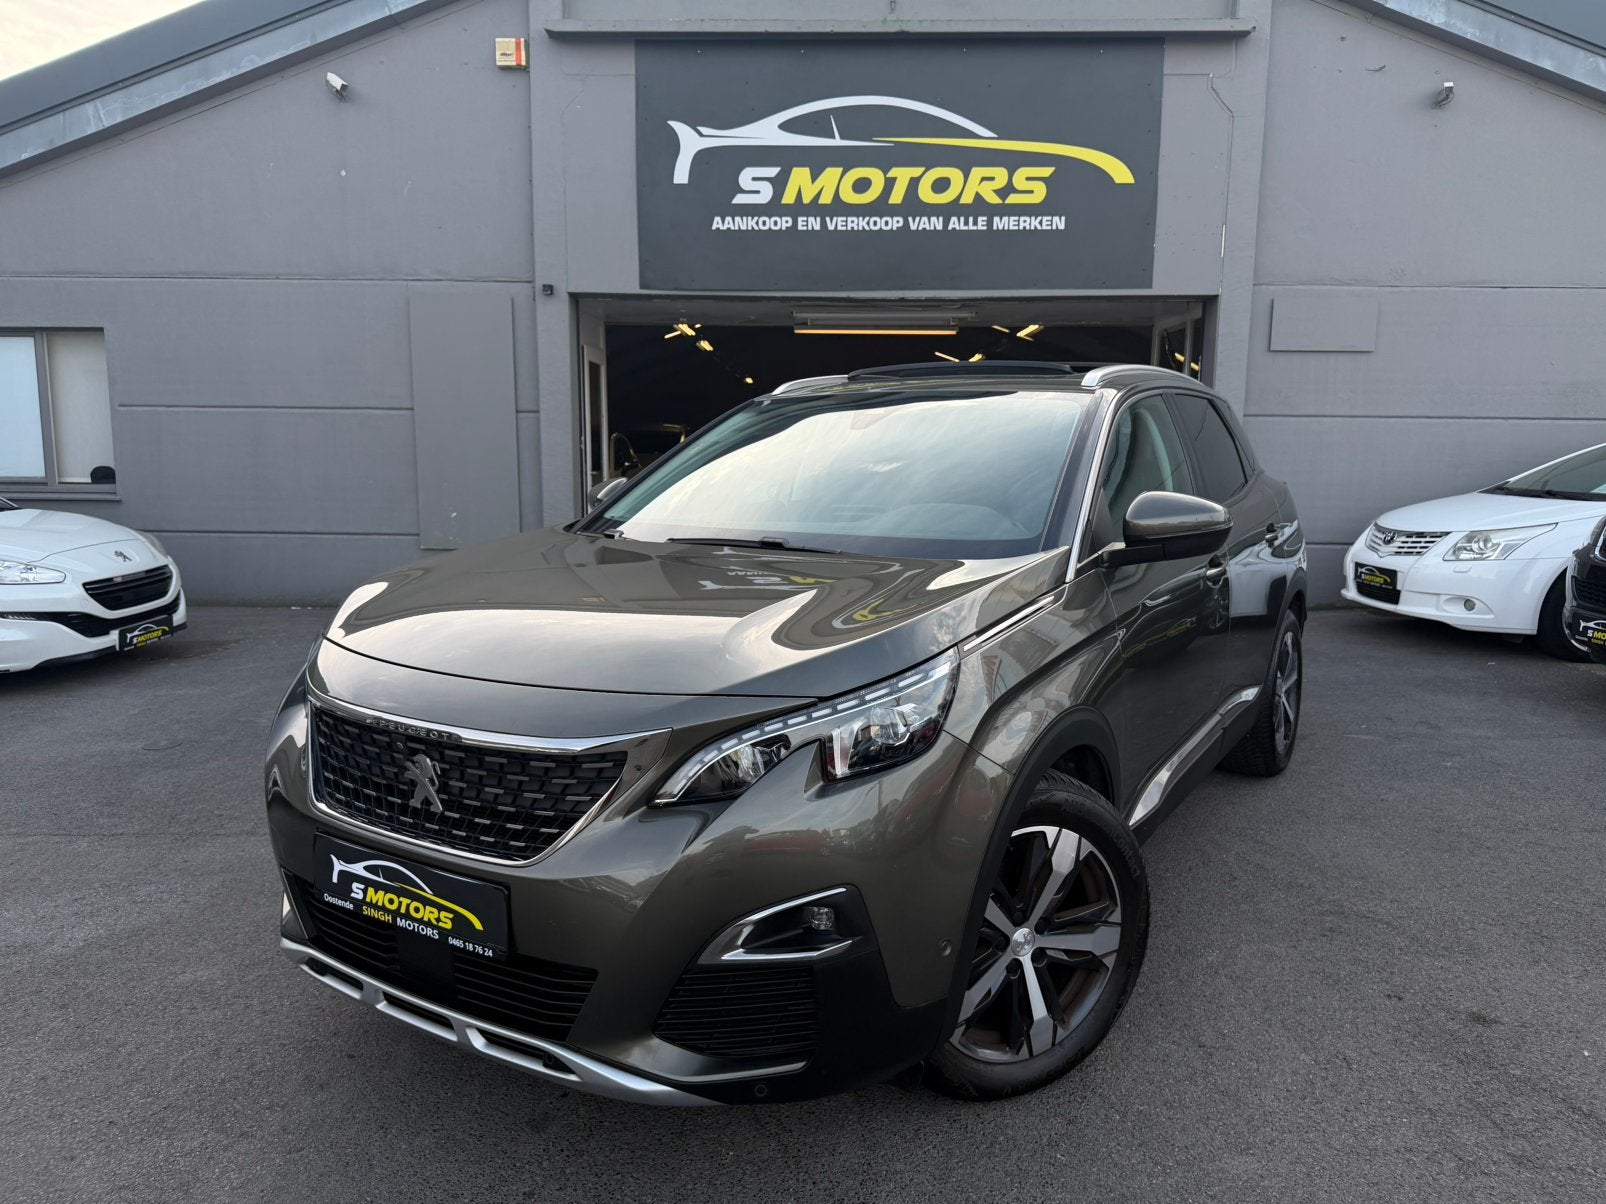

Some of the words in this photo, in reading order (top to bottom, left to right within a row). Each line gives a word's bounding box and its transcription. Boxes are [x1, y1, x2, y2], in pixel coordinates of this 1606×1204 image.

[732, 167, 783, 204] S
[781, 167, 1056, 204] MOTORS
[711, 216, 793, 230] AANKOOP
[798, 216, 820, 230] EN
[826, 216, 903, 230] VERKOOP
[908, 216, 943, 230] VAN
[948, 216, 987, 230] ALLE
[993, 216, 1065, 230] MERKEN
[137, 630, 162, 643] MOTORS
[379, 719, 449, 741] PEUGEOT
[350, 881, 366, 900] S
[365, 886, 455, 930] MOTORS
[323, 893, 354, 911] Oostende
[362, 905, 393, 924] SINGH
[396, 917, 439, 940] MOTORS
[448, 936, 464, 948] 0465
[465, 942, 473, 951] 18
[474, 945, 483, 954] 76
[484, 947, 493, 957] 24
